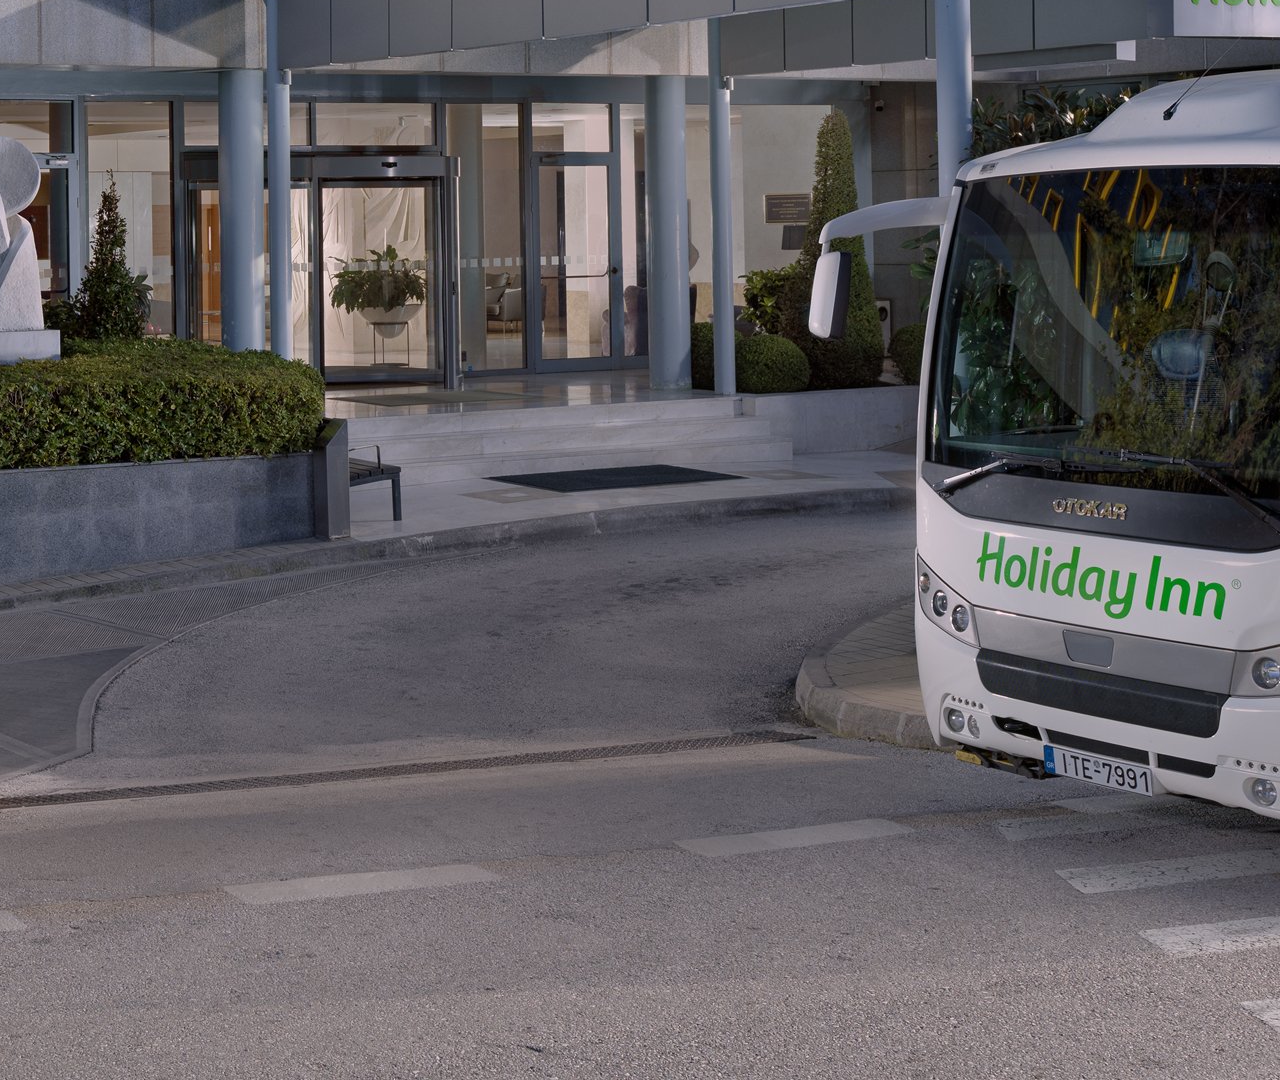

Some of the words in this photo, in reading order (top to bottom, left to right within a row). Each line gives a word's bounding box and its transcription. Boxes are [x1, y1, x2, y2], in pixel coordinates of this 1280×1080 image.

[1052, 497, 1127, 520] OTOKAR
[976, 531, 1137, 619] Holiday
[1145, 555, 1226, 620] Inn
[1062, 753, 1149, 793] ITE-7991
